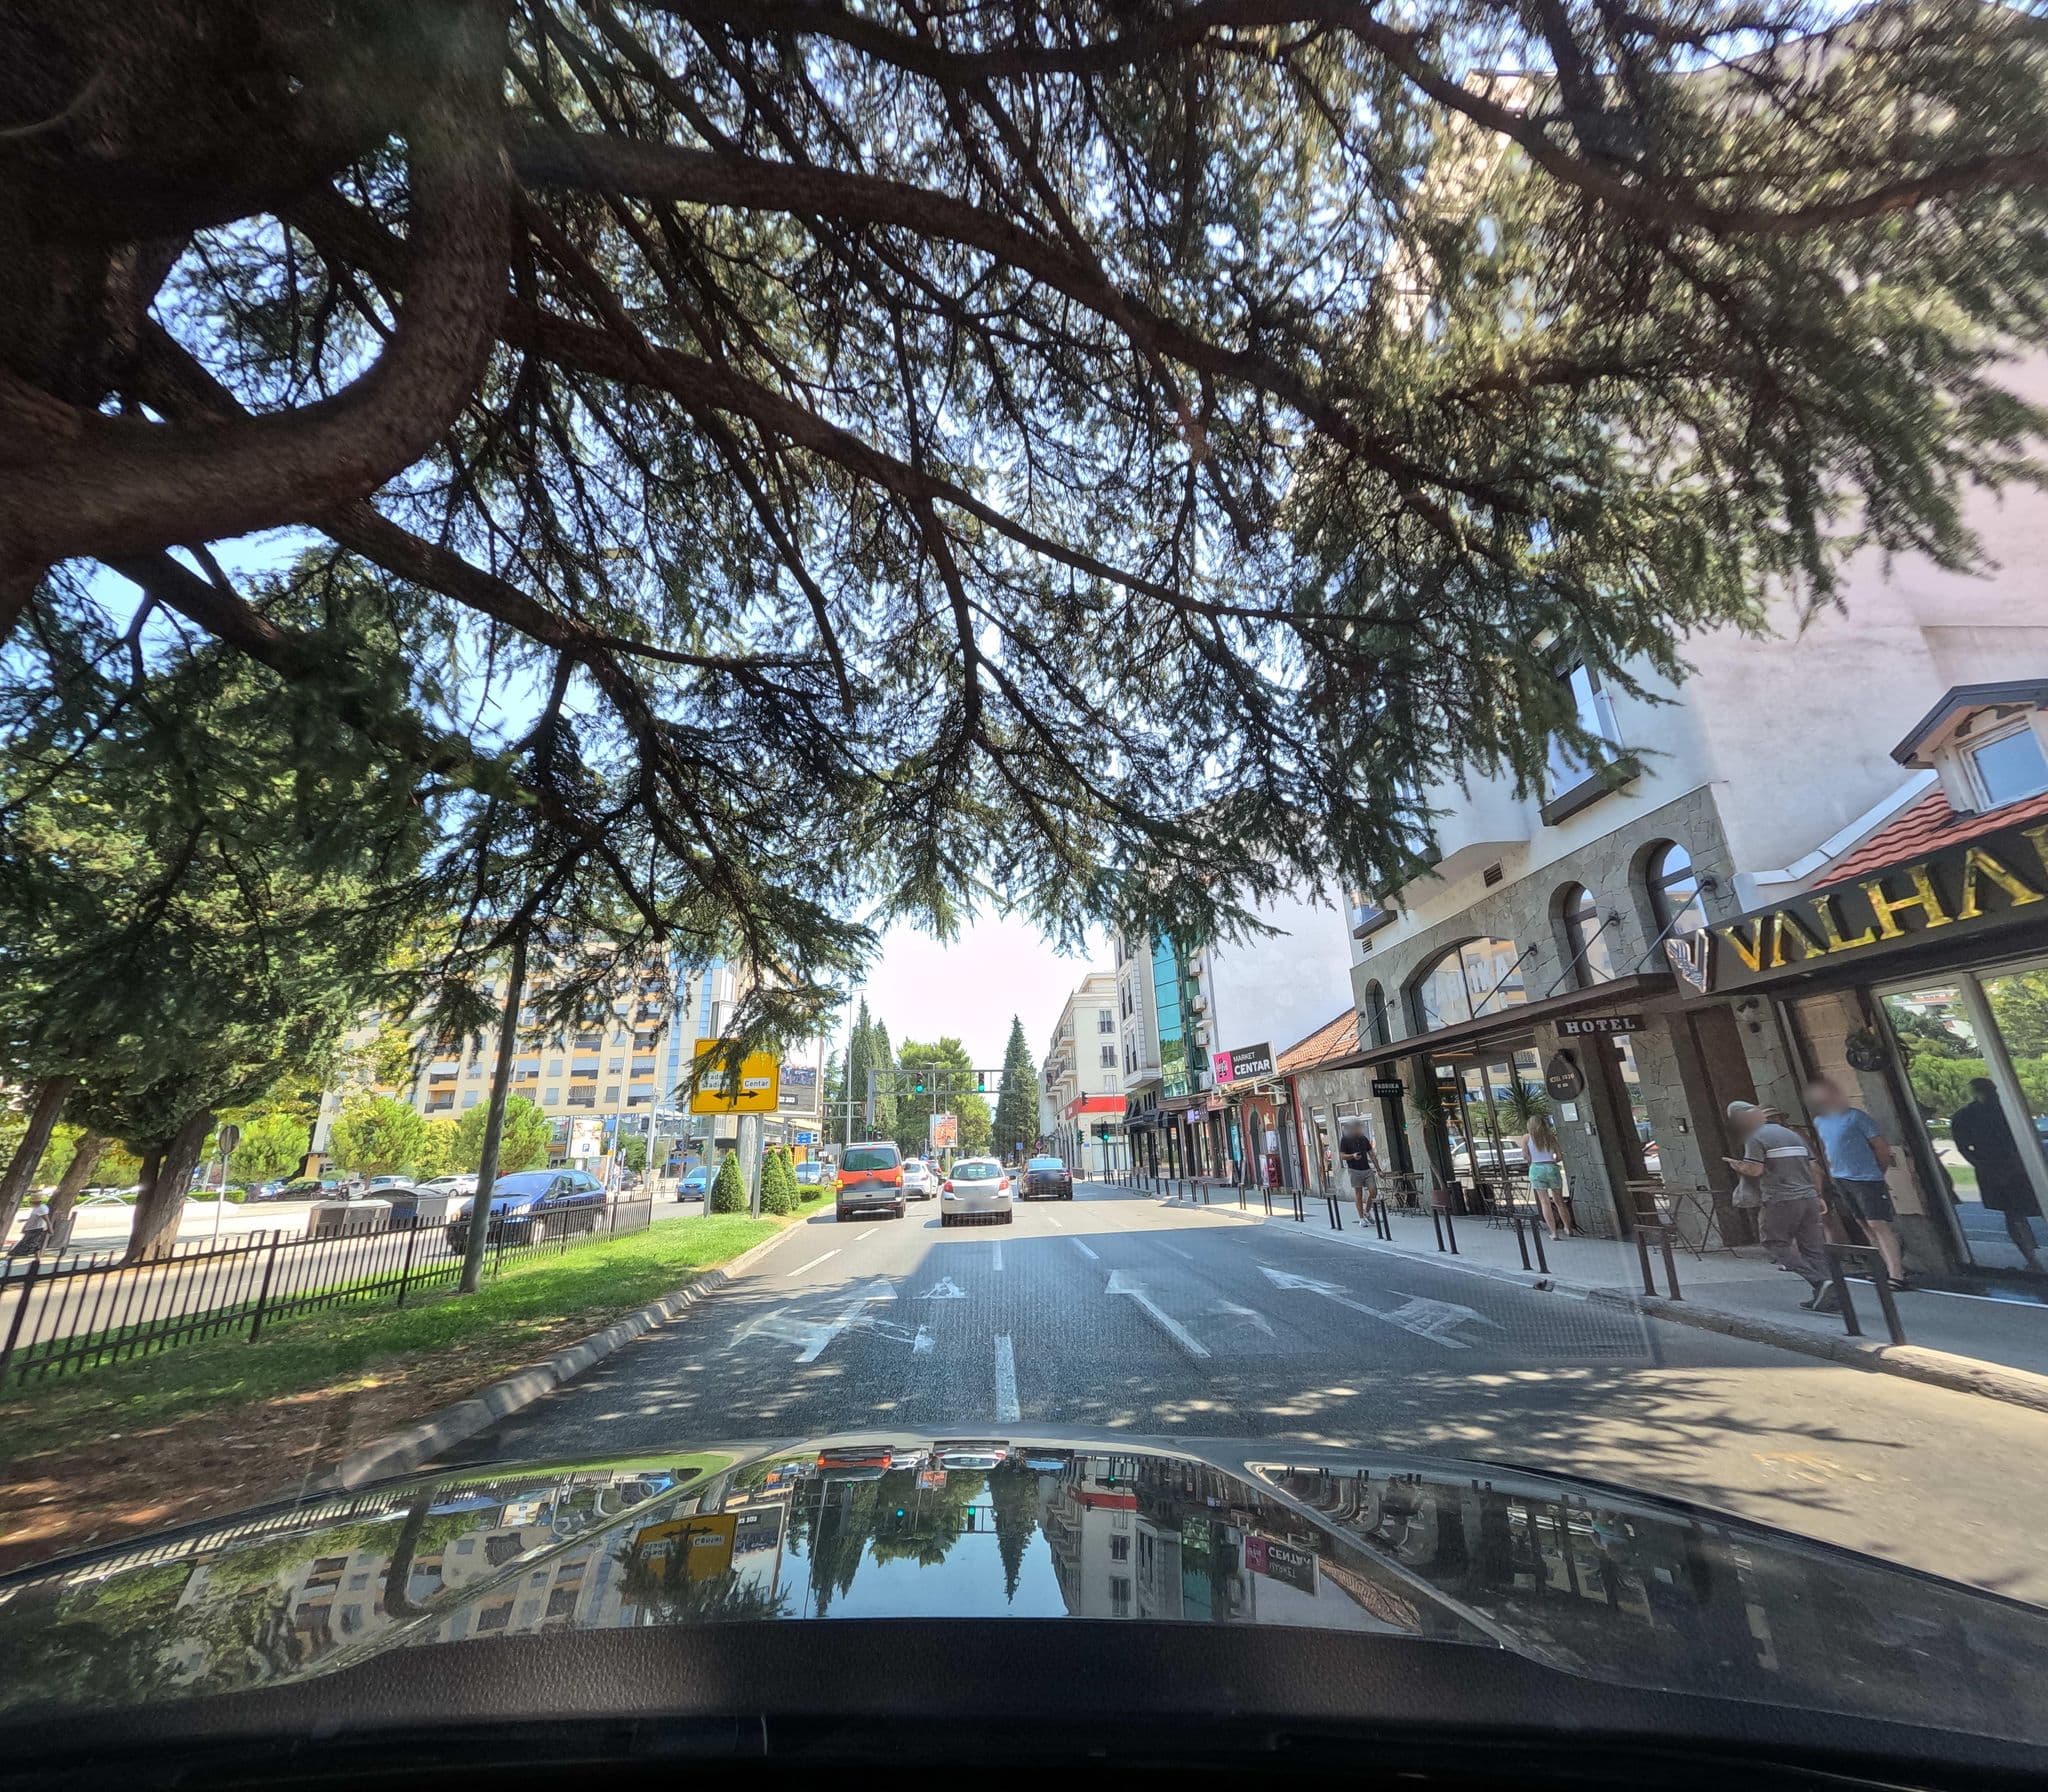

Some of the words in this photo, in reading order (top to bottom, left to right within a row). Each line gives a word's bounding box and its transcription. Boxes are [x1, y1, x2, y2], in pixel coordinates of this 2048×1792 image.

[1565, 1018, 1635, 1034] HOTEL
[1233, 1051, 1255, 1062] MARKET
[1234, 1059, 1271, 1075] CENTAR
[744, 1079, 769, 1088] Centar
